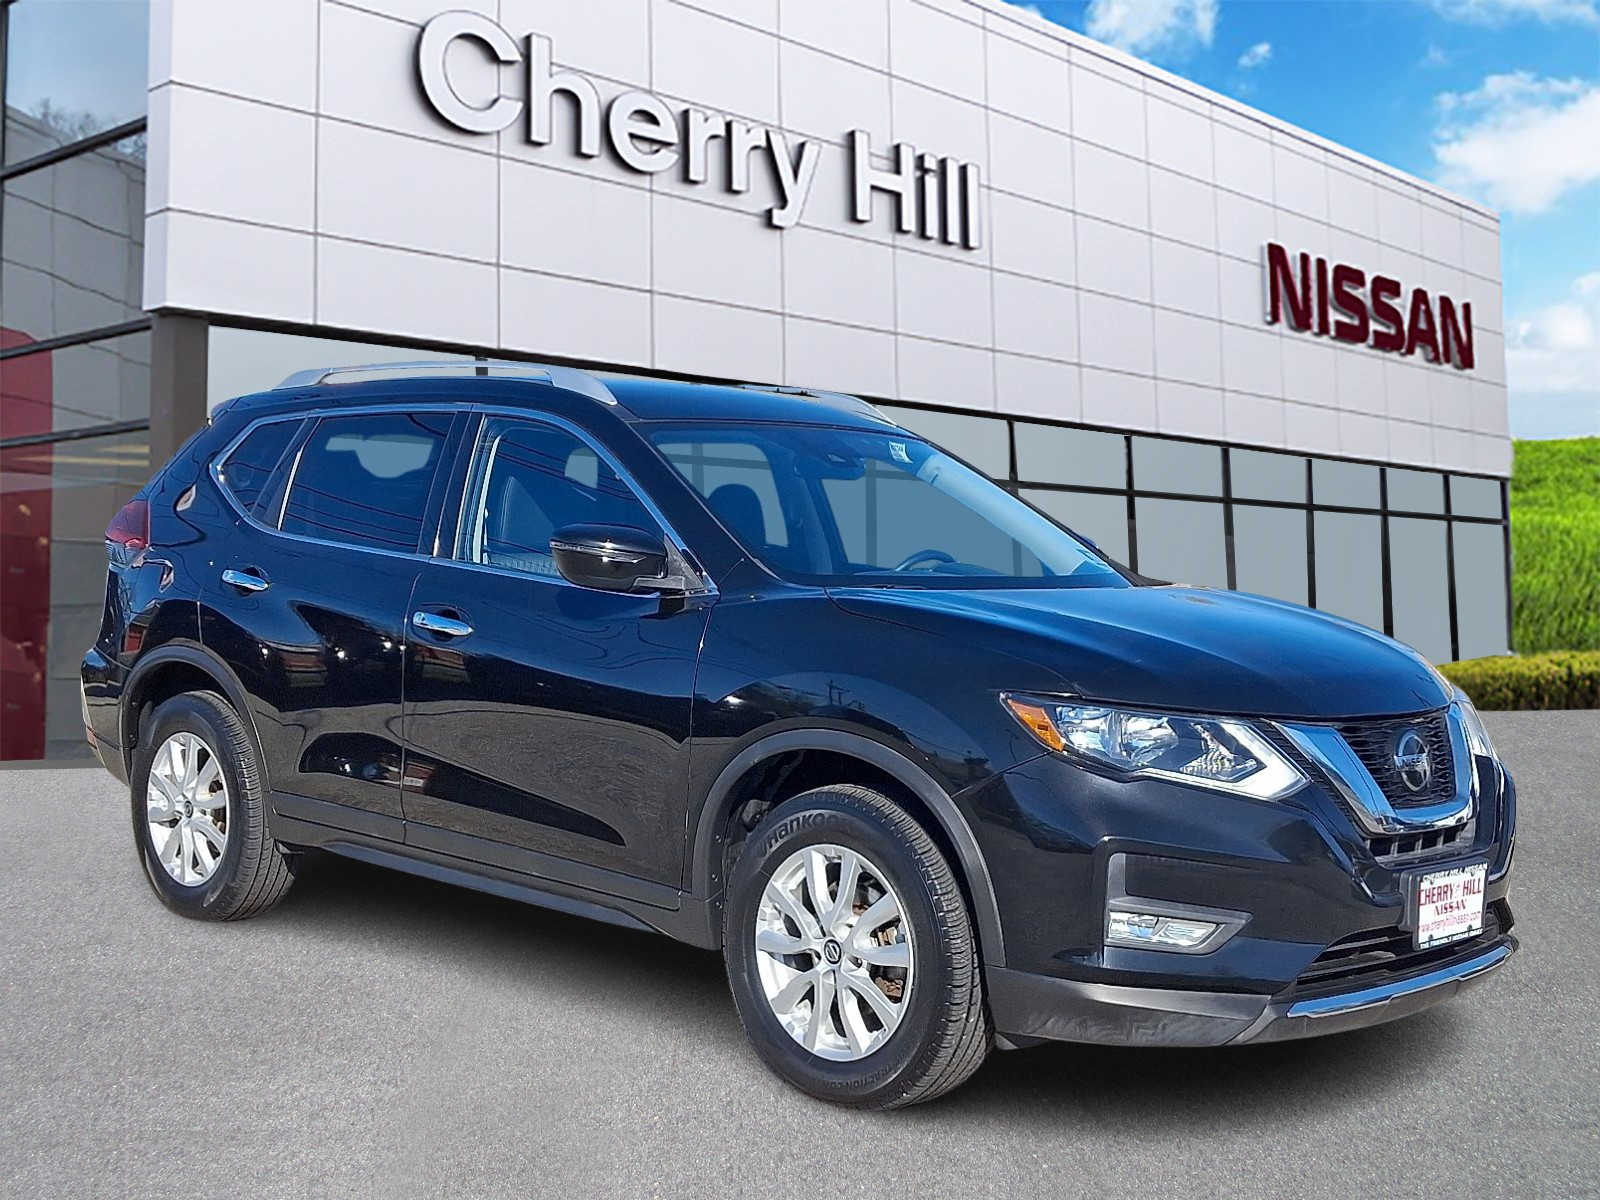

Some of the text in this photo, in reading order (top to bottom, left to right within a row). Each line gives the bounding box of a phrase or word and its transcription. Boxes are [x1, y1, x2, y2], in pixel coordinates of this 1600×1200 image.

[416, 10, 980, 249] Cherry Hill
[1264, 242, 1475, 370] NISSAN
[1417, 878, 1482, 906] CHERRY HILL
[1435, 898, 1467, 916] NISSAN
